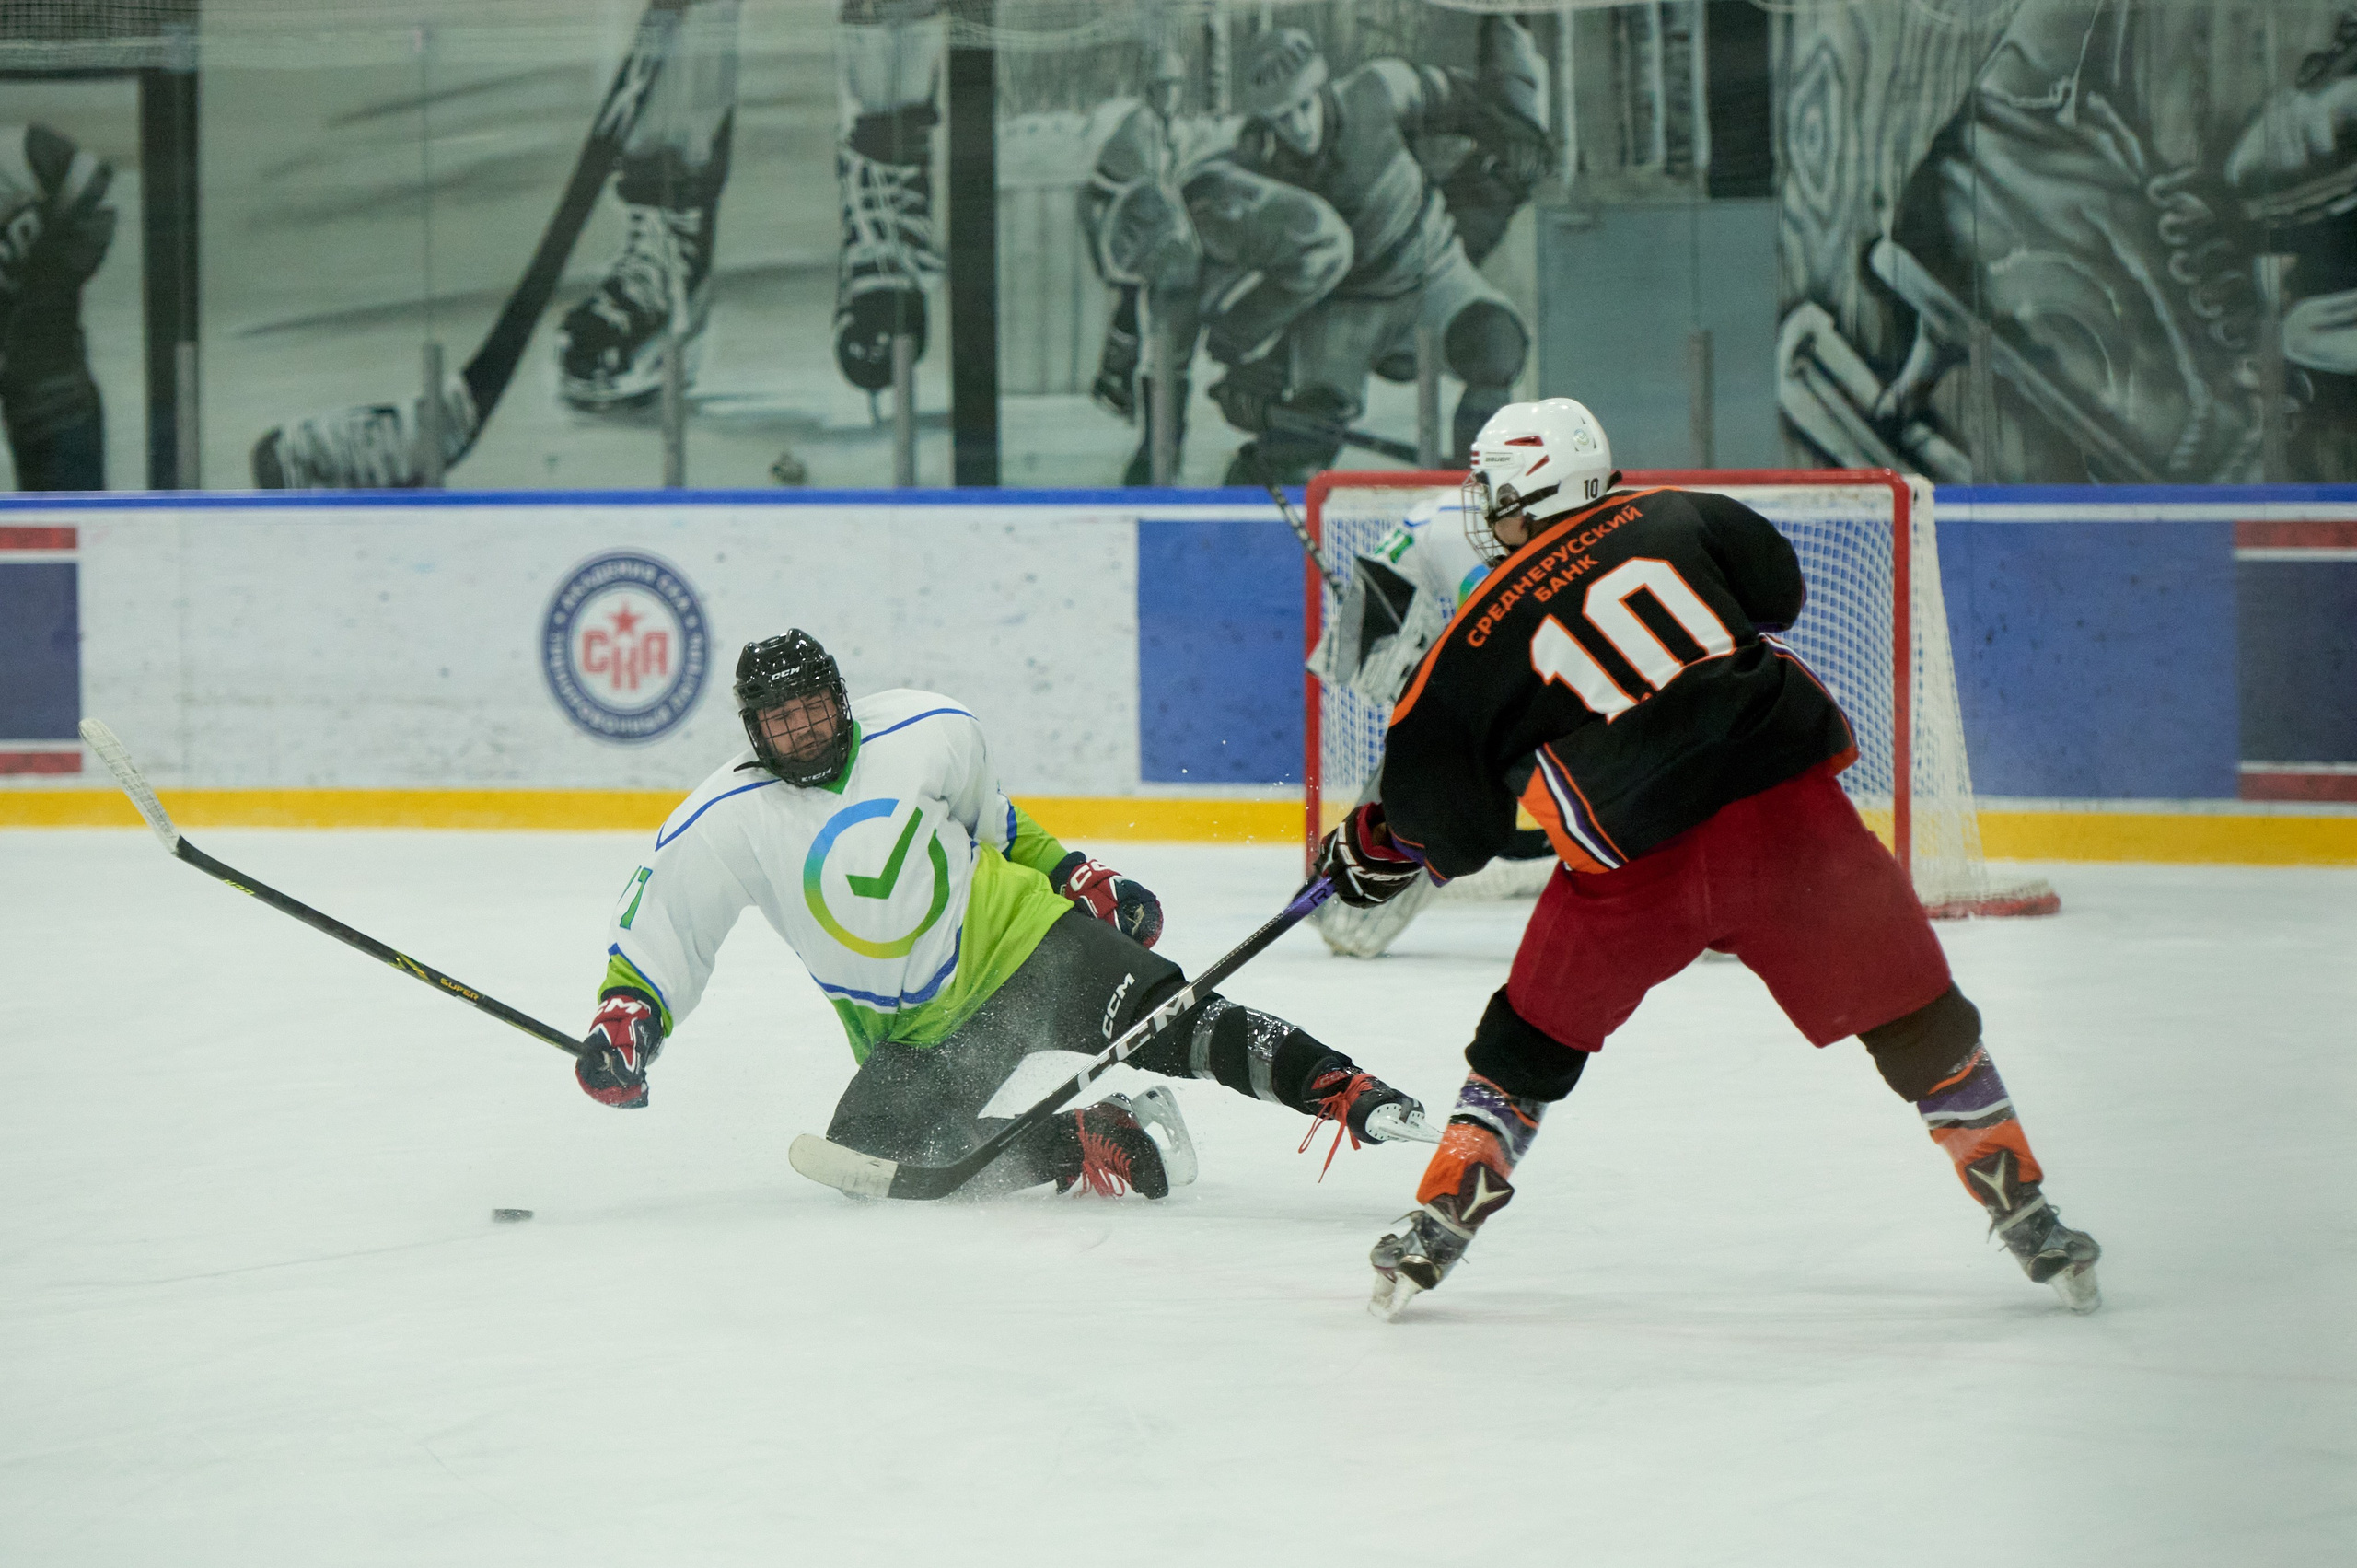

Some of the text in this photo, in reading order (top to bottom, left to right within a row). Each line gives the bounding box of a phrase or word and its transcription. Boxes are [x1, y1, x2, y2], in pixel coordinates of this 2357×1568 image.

[1584, 478, 1599, 500] 10
[1467, 505, 1643, 647] СРЕДНЕРУССКИЙ
[1533, 555, 1599, 603] БАНК
[1530, 556, 1736, 726] 10
[772, 666, 800, 681] CCM
[1069, 860, 1113, 892] CC
[439, 977, 479, 1001] SUPER
[1102, 972, 1136, 1040] CCM
[1077, 985, 1196, 1092] CCM
